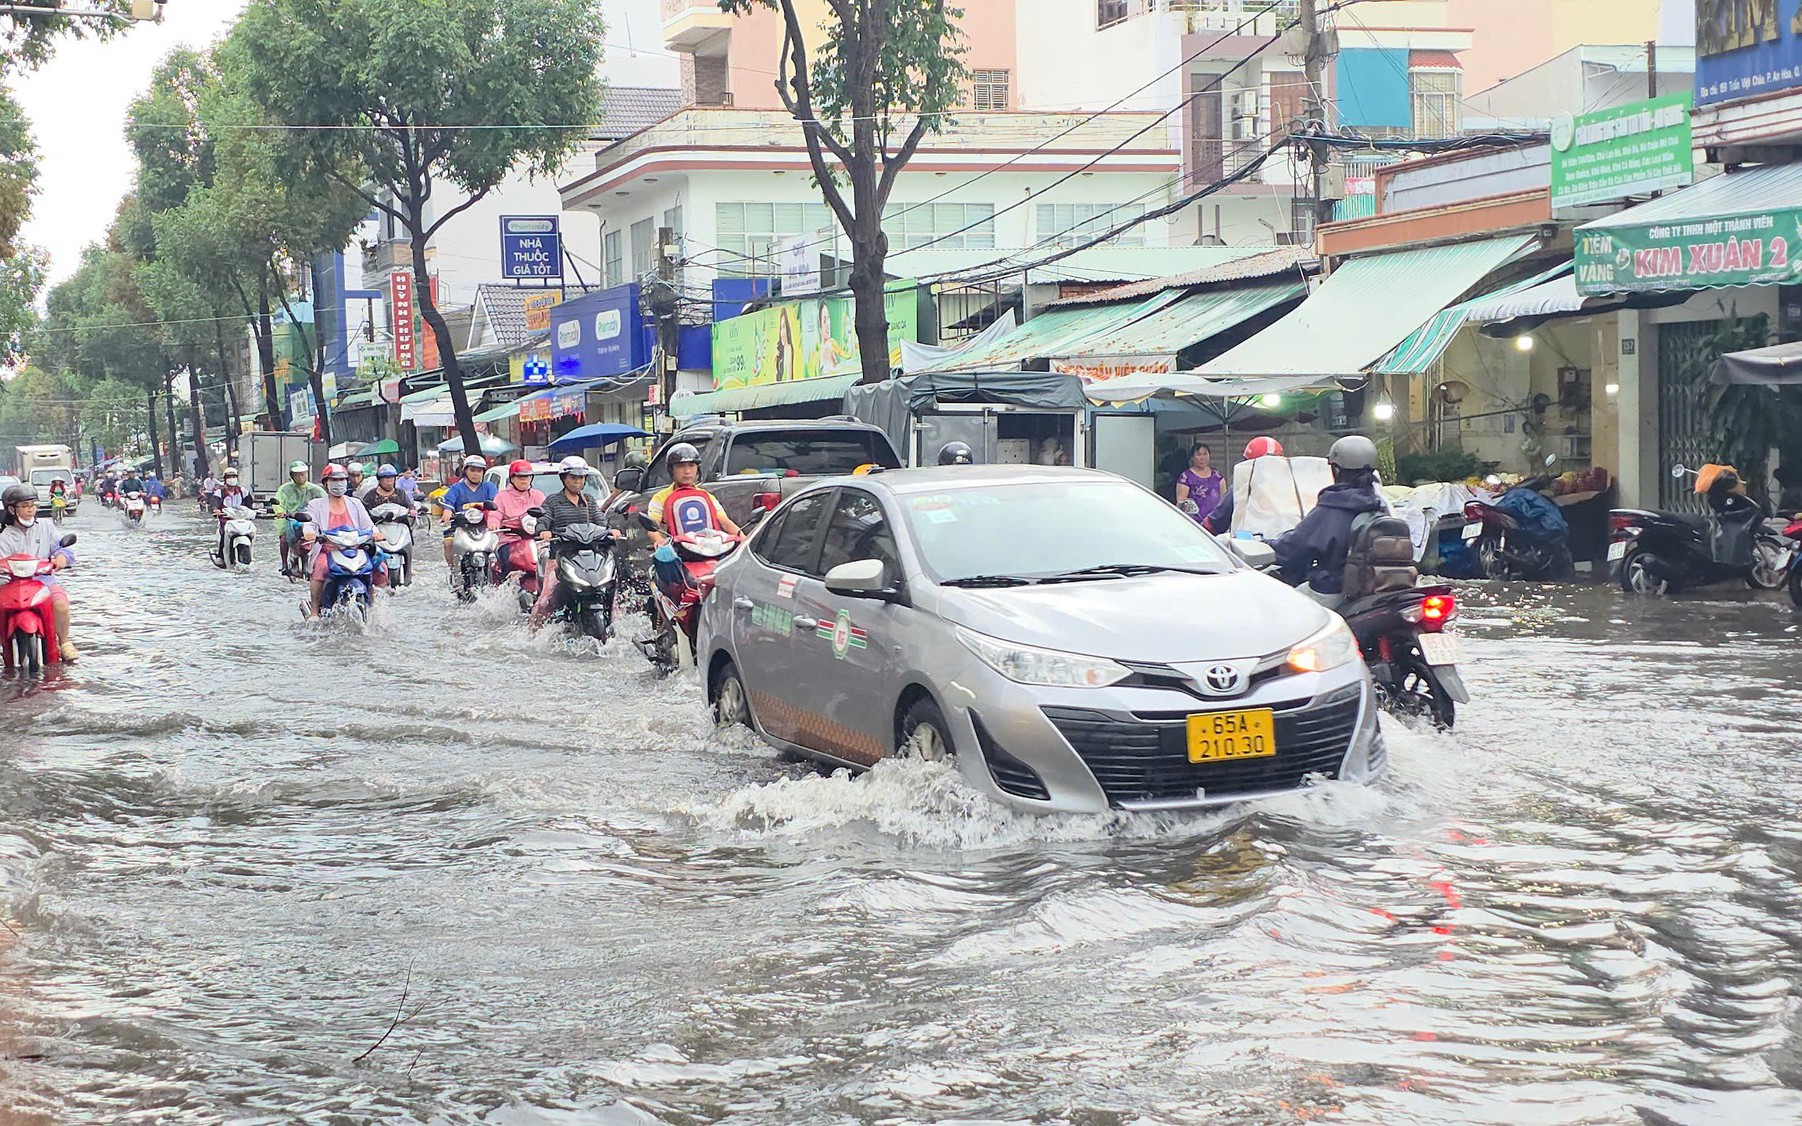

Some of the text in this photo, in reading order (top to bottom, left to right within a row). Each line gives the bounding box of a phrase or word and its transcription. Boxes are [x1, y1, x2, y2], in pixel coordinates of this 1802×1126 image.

[1650, 215, 1774, 240] CÔNG TY TNHH MỘT THÀNH VIÊN
[519, 237, 542, 248] NHÀ
[513, 249, 549, 262] THUỐC
[1634, 235, 1788, 278] KIM XUÂN 2
[513, 261, 551, 274] GIÁ TỐT
[1579, 262, 1615, 282] VÀNG
[1213, 714, 1247, 734] 65A
[1200, 735, 1264, 758] 210.30
